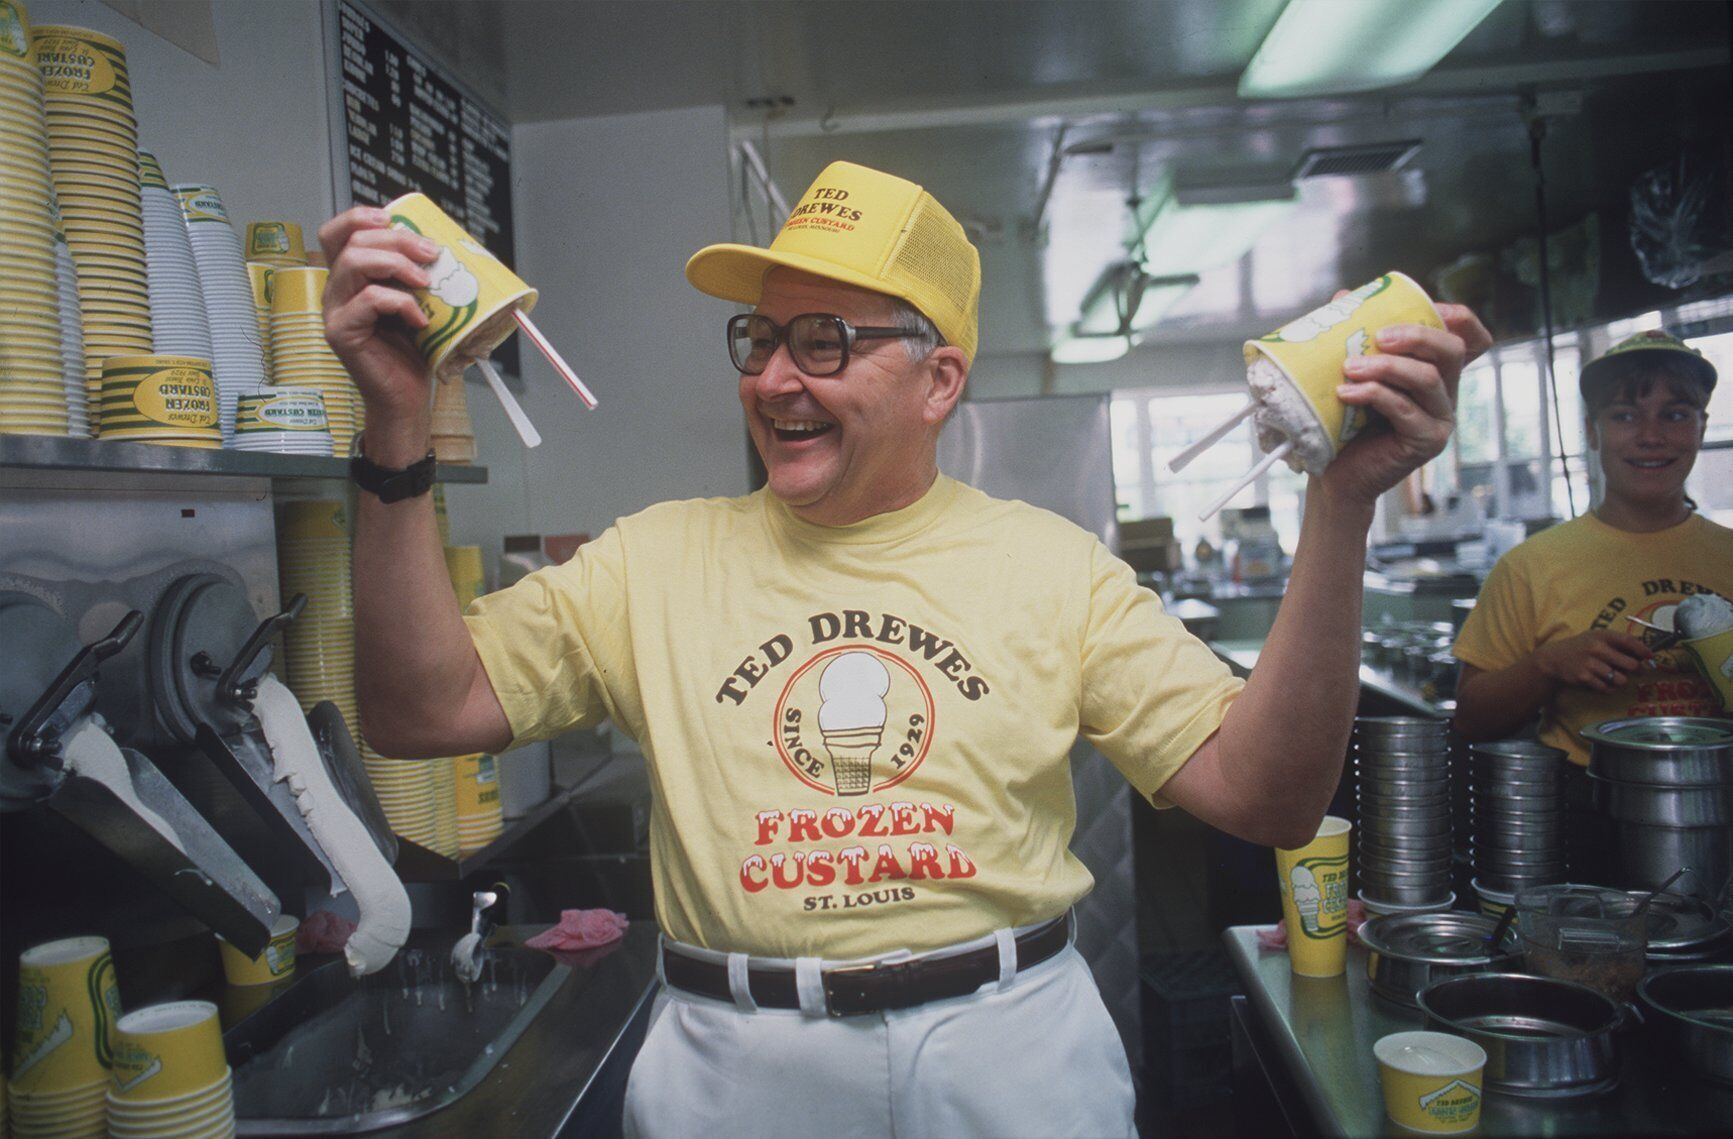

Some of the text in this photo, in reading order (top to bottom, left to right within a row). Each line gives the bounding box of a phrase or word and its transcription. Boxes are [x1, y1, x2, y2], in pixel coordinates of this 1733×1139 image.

[814, 188, 849, 201] TED
[791, 202, 863, 222] DREWES
[810, 217, 855, 232] CUSTARD
[159, 384, 211, 399] CUSTARD
[165, 398, 210, 412] FROZEN
[1590, 597, 1627, 630] TED
[715, 609, 990, 706] TED DREWES
[783, 706, 825, 779] SINCE
[889, 713, 925, 769] 1929
[754, 801, 956, 846] FROZEN
[739, 841, 977, 893] CUSTARD
[803, 886, 916, 911] ST. LOUIS
